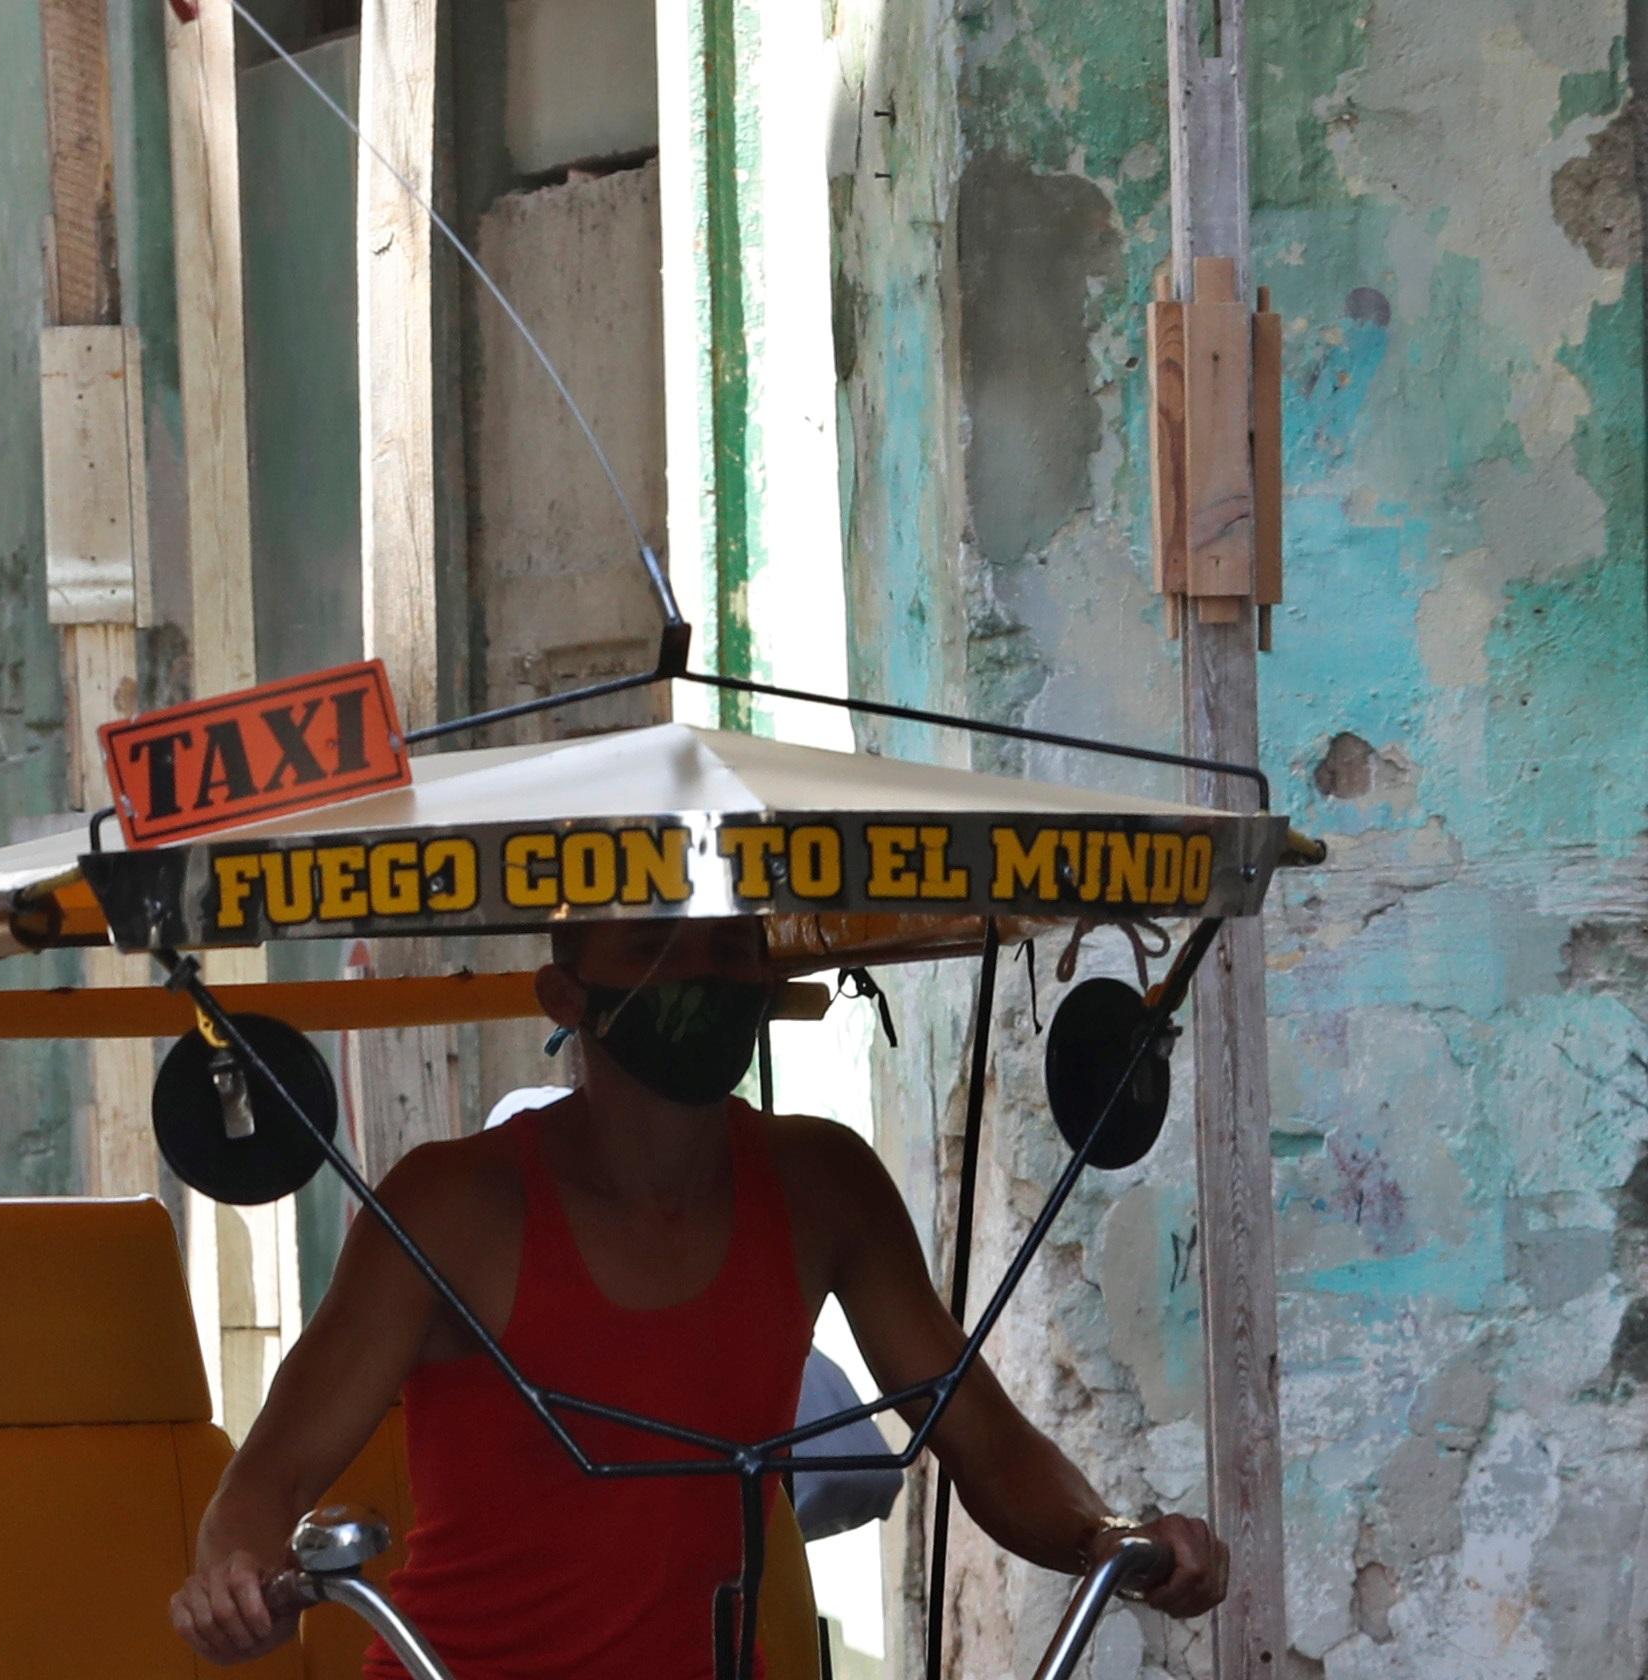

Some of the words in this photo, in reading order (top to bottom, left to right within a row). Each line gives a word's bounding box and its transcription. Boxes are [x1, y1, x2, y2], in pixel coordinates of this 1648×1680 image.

[130, 688, 371, 822] TAXI
[213, 836, 479, 930] FUEGO
[503, 826, 694, 909] CON
[718, 825, 845, 900] TO
[865, 824, 969, 901] EL
[992, 827, 1215, 905] MUNDO
